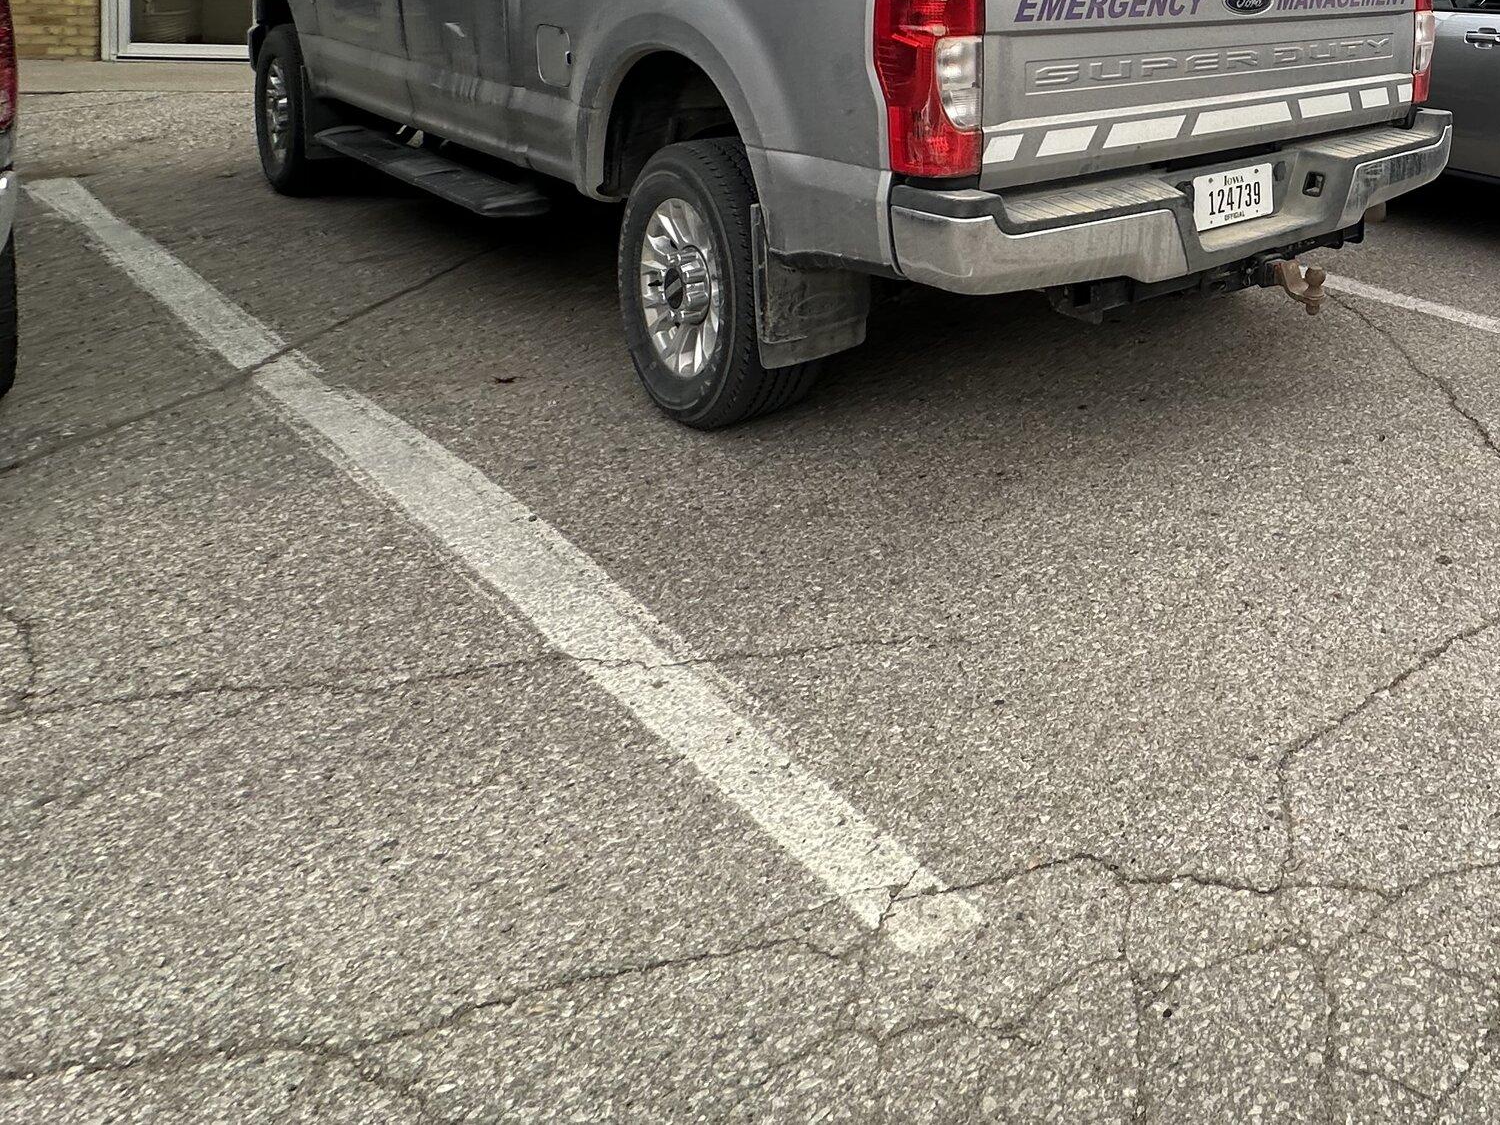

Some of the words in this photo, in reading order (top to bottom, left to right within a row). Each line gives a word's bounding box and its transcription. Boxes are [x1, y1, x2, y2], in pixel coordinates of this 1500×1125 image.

[1034, 50, 1259, 86] SUPER
[1273, 37, 1390, 63] DUTY
[1208, 181, 1261, 216] 124739
[1224, 210, 1246, 222] OFFICIAL
